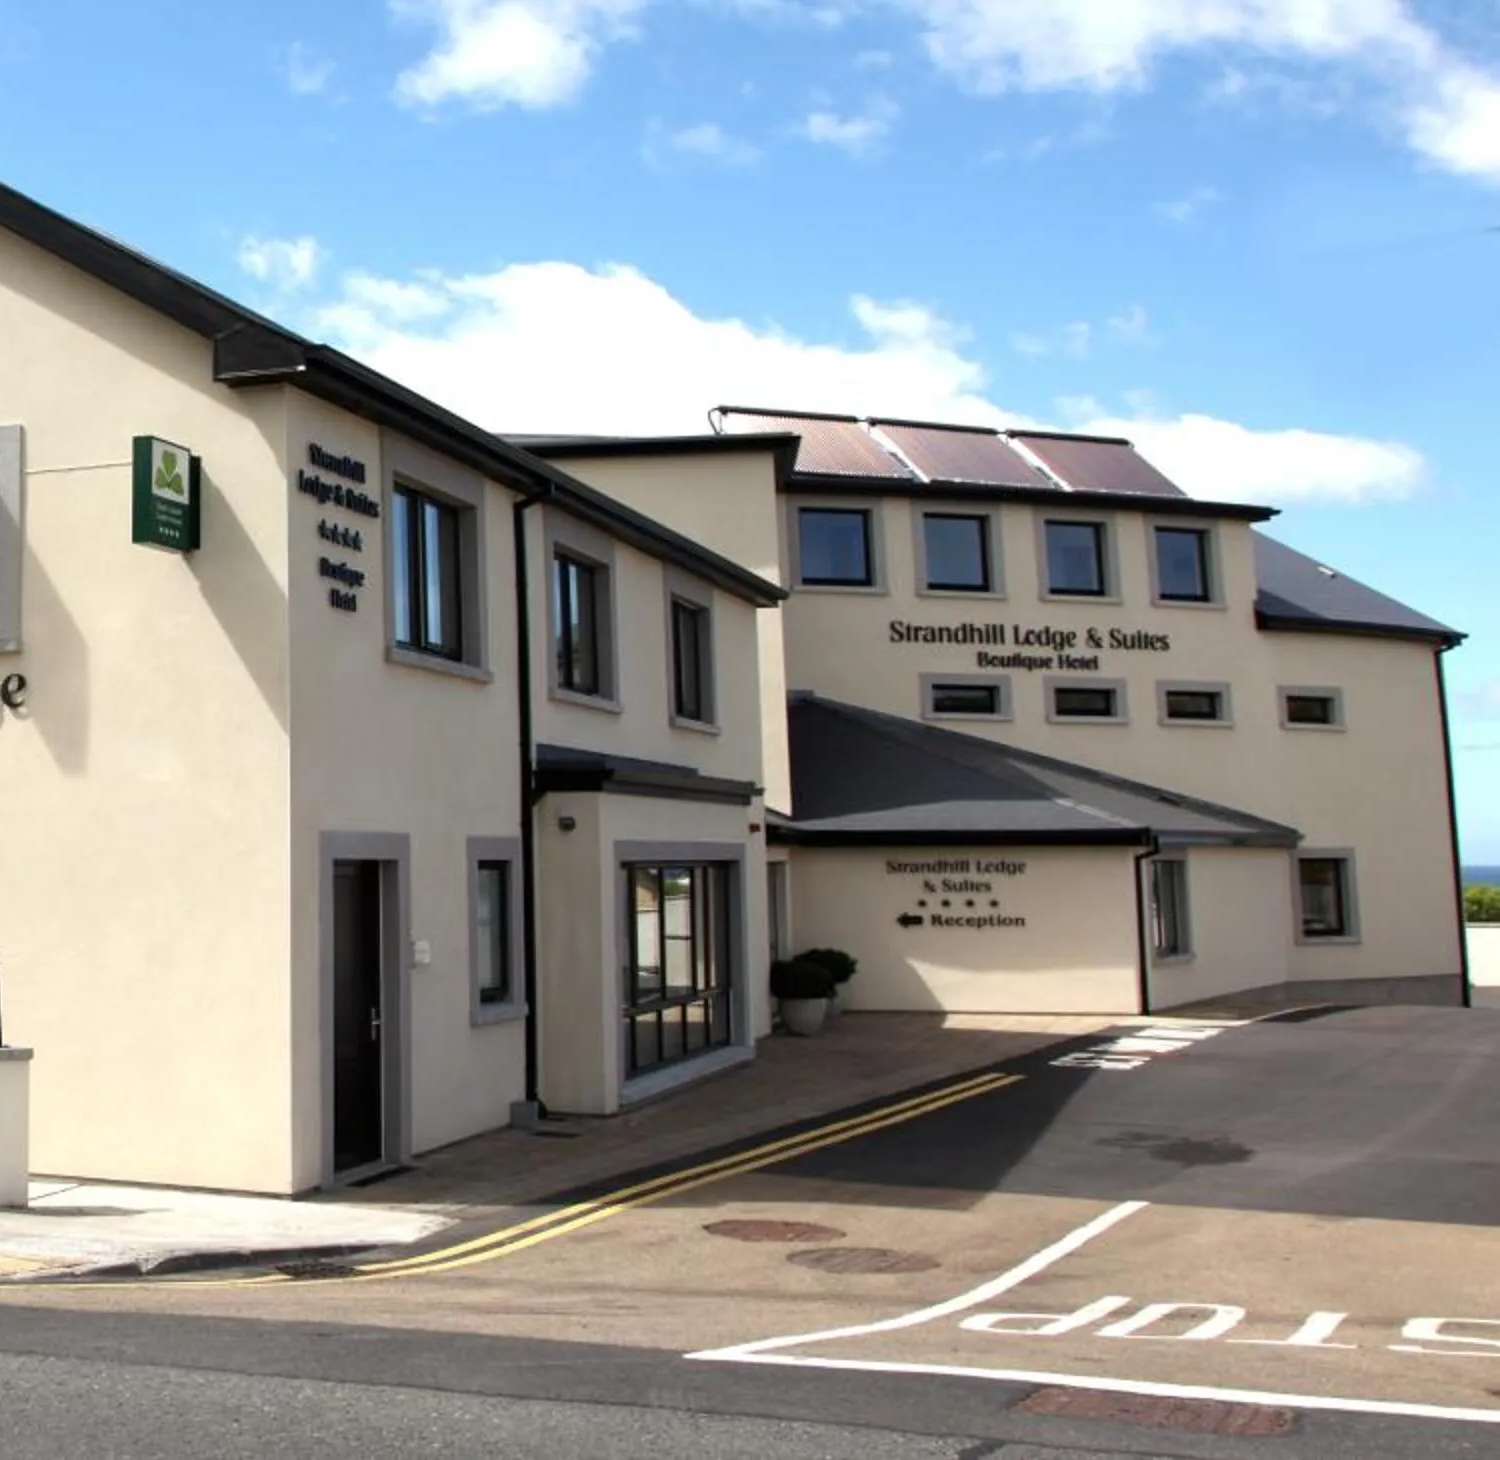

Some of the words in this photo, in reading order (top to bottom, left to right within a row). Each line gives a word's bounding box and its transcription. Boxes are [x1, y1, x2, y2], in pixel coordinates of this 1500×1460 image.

[889, 620, 1005, 645] Strandhill
[1012, 624, 1077, 651] Lodge
[1085, 627, 1103, 649] &
[1108, 627, 1171, 651] Suites
[976, 651, 1053, 671] Boutique
[1057, 654, 1099, 671] Hotel
[885, 859, 970, 874] Strandhill
[975, 859, 1027, 876] Lodge
[941, 879, 992, 893] Suites
[930, 913, 1026, 930] Reception
[958, 1296, 1500, 1357] STOP
